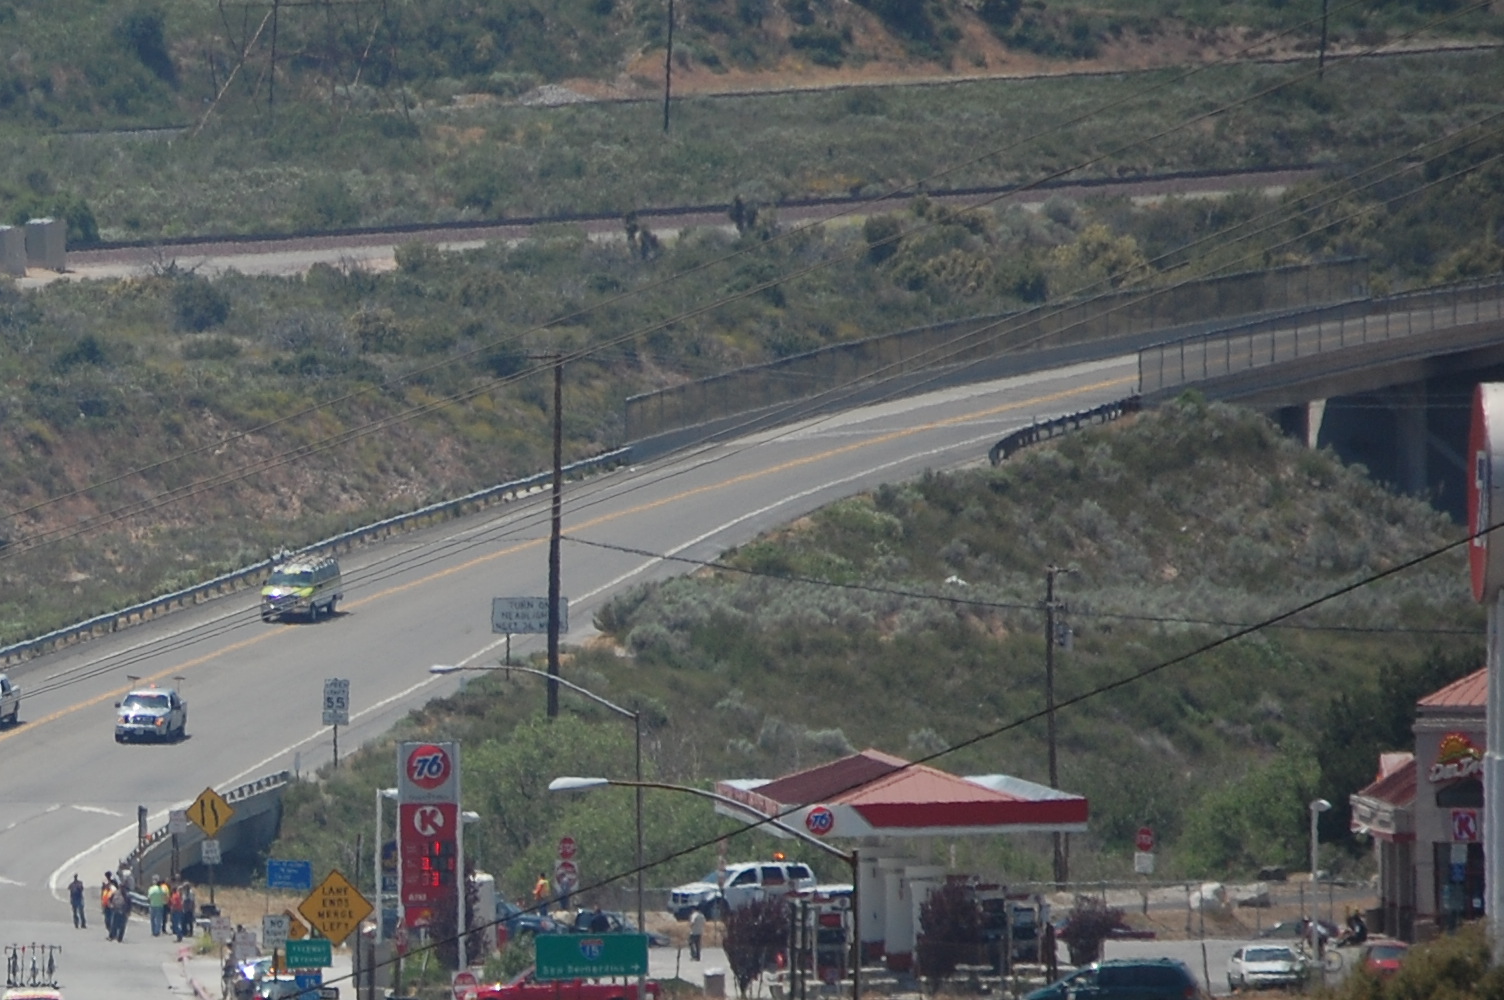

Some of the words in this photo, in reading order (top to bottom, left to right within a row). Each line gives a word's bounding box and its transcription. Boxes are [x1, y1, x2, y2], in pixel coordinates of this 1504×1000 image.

[326, 697, 345, 708] 55
[414, 754, 443, 780] 76
[811, 811, 830, 828] 76
[322, 887, 348, 896] LANE
[322, 898, 349, 908] ENDS
[317, 910, 353, 919] MERGE
[322, 922, 348, 932] LEFT
[586, 945, 600, 957] 15
